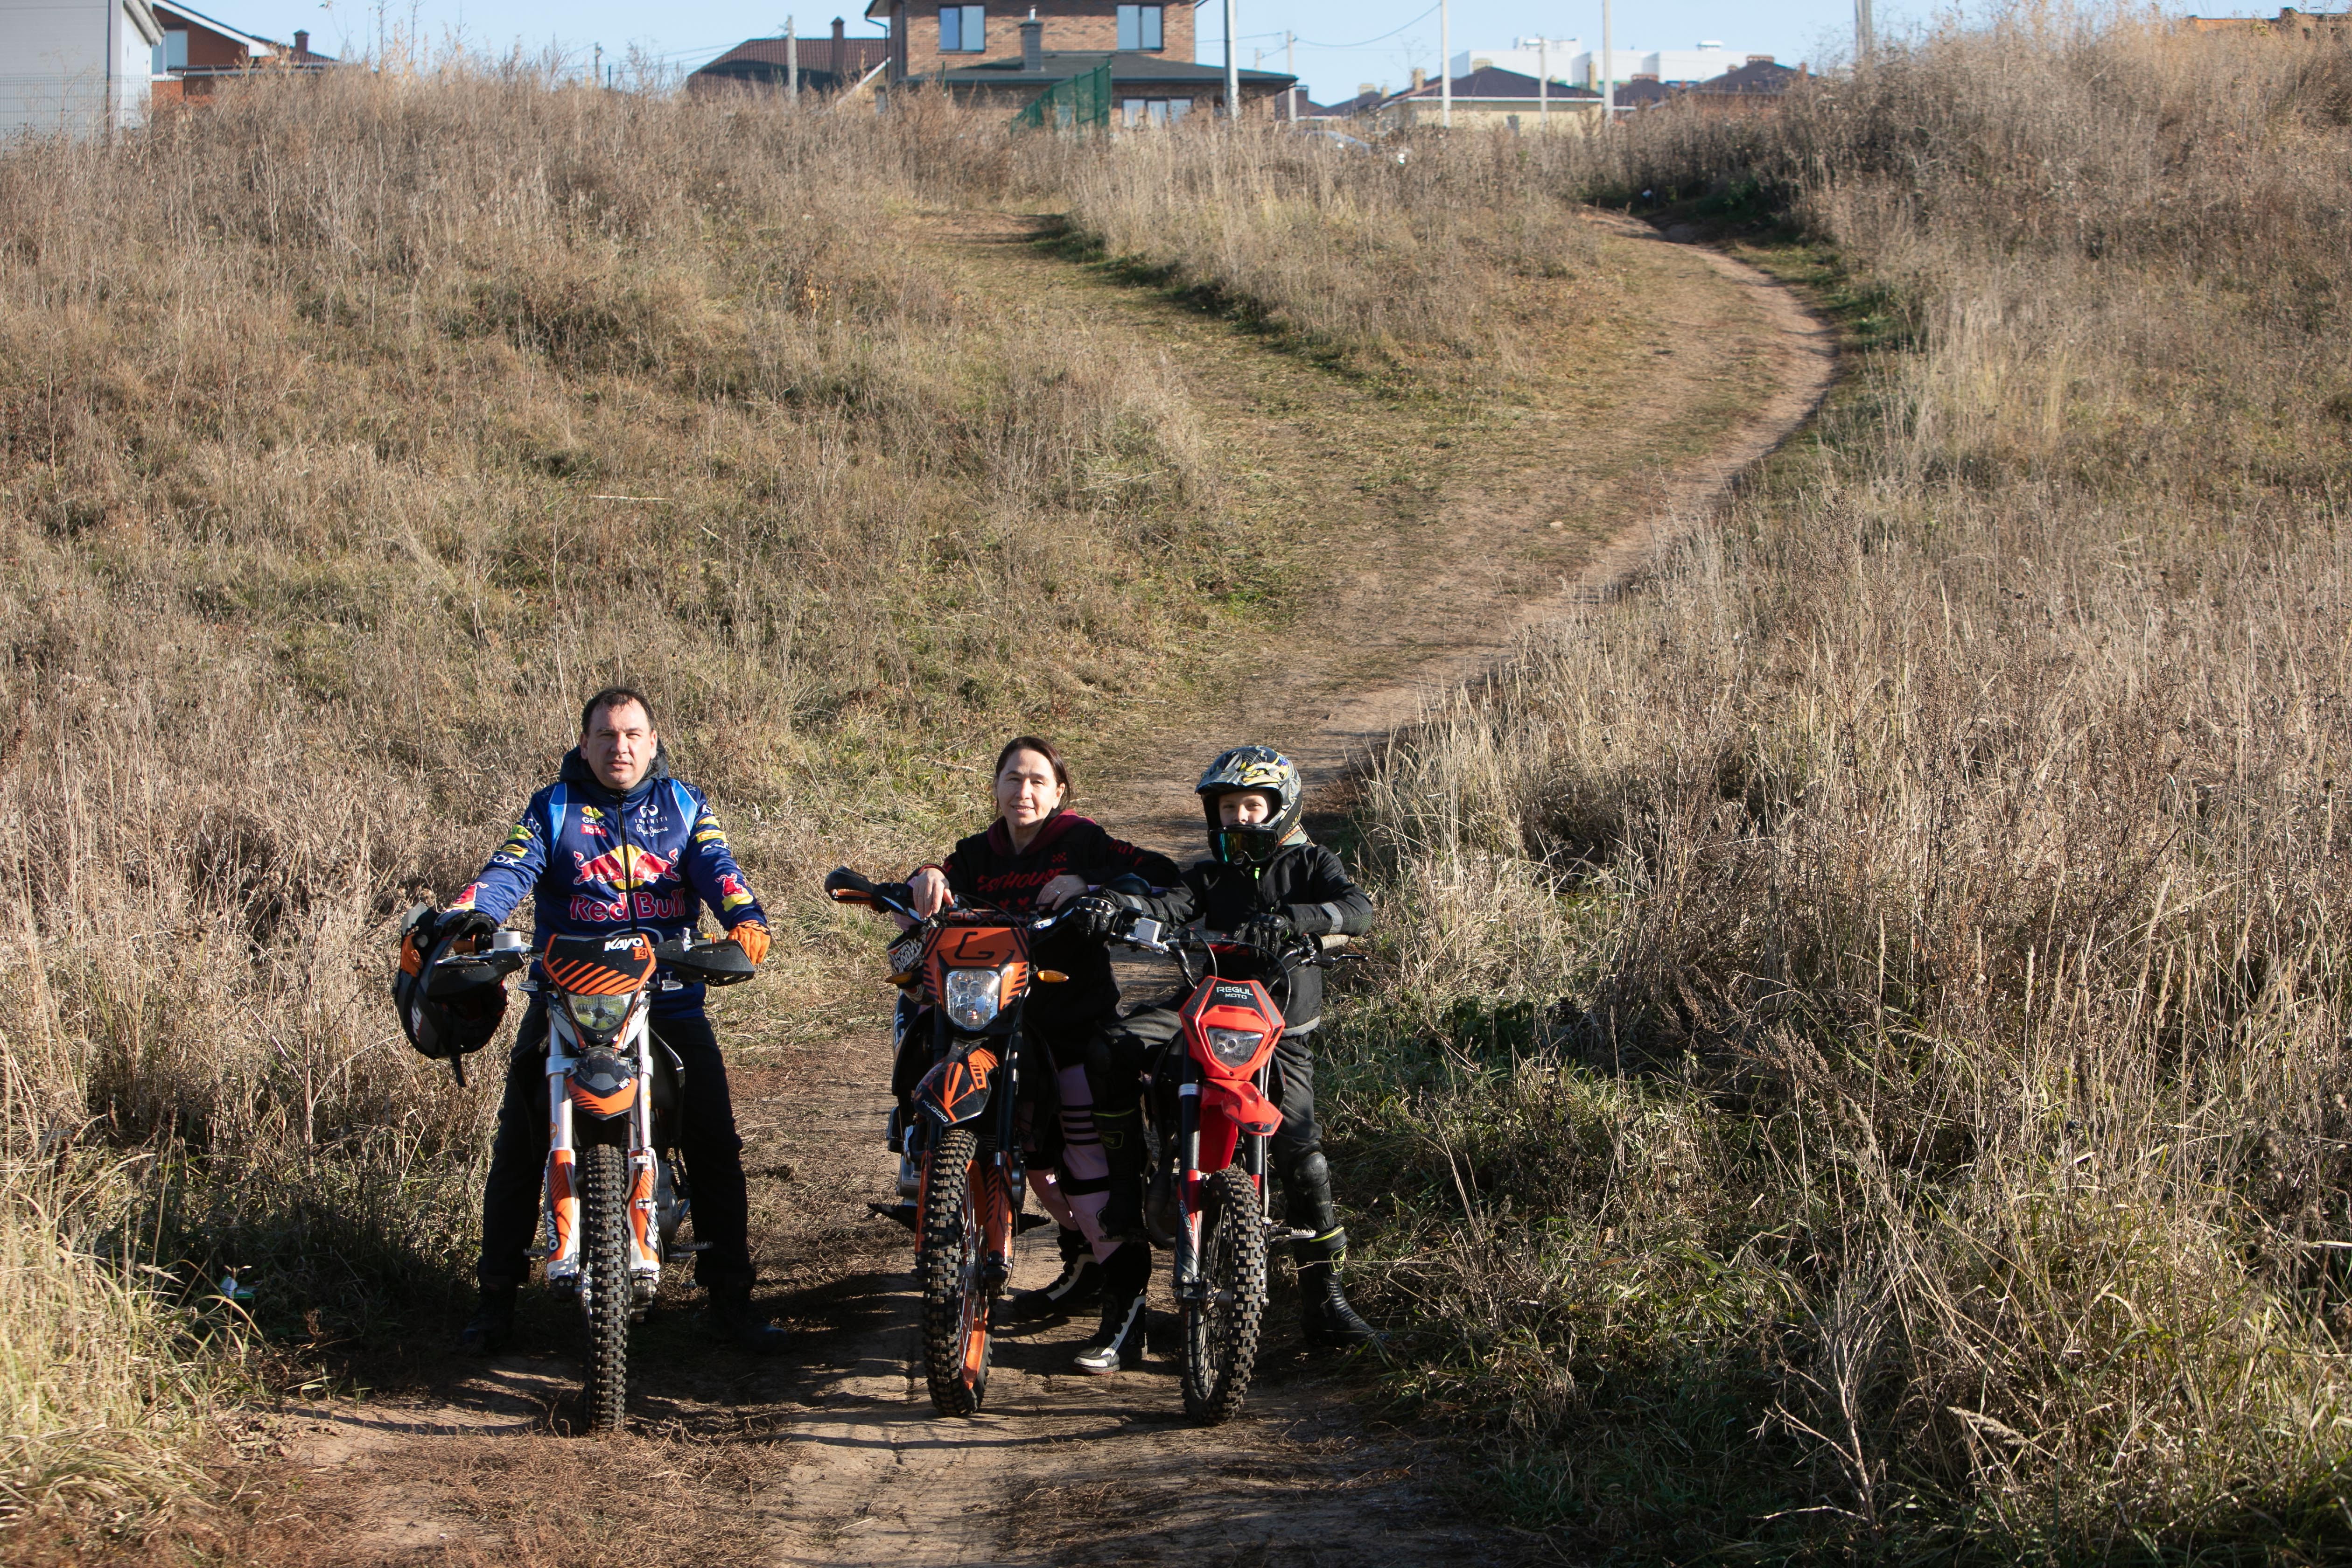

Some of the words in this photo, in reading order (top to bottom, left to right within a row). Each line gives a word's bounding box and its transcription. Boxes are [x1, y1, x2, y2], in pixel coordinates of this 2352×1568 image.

[582, 817, 605, 827] GEX
[635, 816, 668, 825] INFINITI
[636, 824, 650, 838] Pepe
[649, 826, 669, 837] Jeans
[570, 892, 631, 922] Red
[633, 888, 686, 919] Bull
[604, 937, 644, 952] KAYO
[1216, 987, 1253, 996] REGUL
[922, 1099, 949, 1122] KUGOO
[546, 1211, 559, 1251] KAYO
